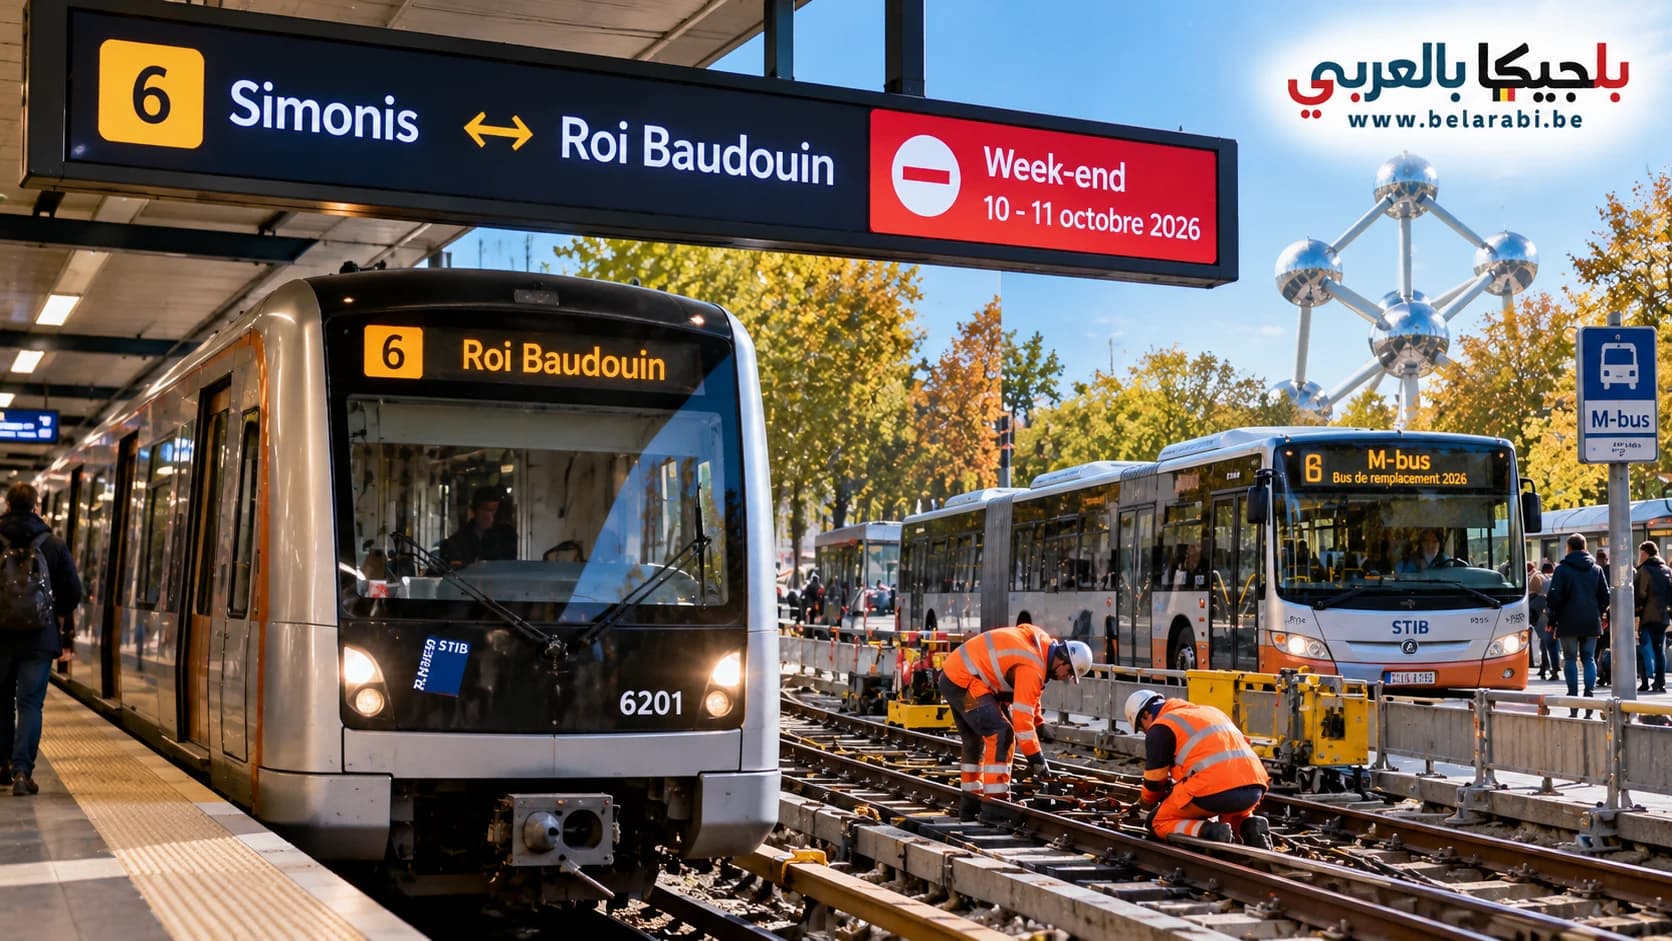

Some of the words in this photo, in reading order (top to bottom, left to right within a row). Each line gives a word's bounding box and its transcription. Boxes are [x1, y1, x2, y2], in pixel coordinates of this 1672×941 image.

[132, 65, 171, 124] 6
[229, 79, 419, 144] Simonis
[561, 115, 628, 164] Roi
[643, 124, 834, 186] Baudouin
[984, 145, 1126, 192] Week-end
[984, 195, 1010, 222] 10
[1032, 200, 1052, 226] 11
[1059, 207, 1144, 235] octobre
[1150, 213, 1200, 240] 2026
[381, 334, 405, 370] 6
[463, 338, 512, 372] Roi
[523, 342, 665, 381] Baudouin
[1591, 409, 1650, 428] M-bus
[1305, 453, 1322, 483] 6
[1368, 449, 1431, 470] M-bus
[1332, 471, 1353, 484] Bus
[1354, 471, 1369, 484] de
[1370, 471, 1440, 487] remplacement
[1442, 472, 1468, 485] 2026
[1392, 620, 1429, 635] STIB
[438, 639, 468, 654] STIB
[620, 689, 682, 716] 6201
